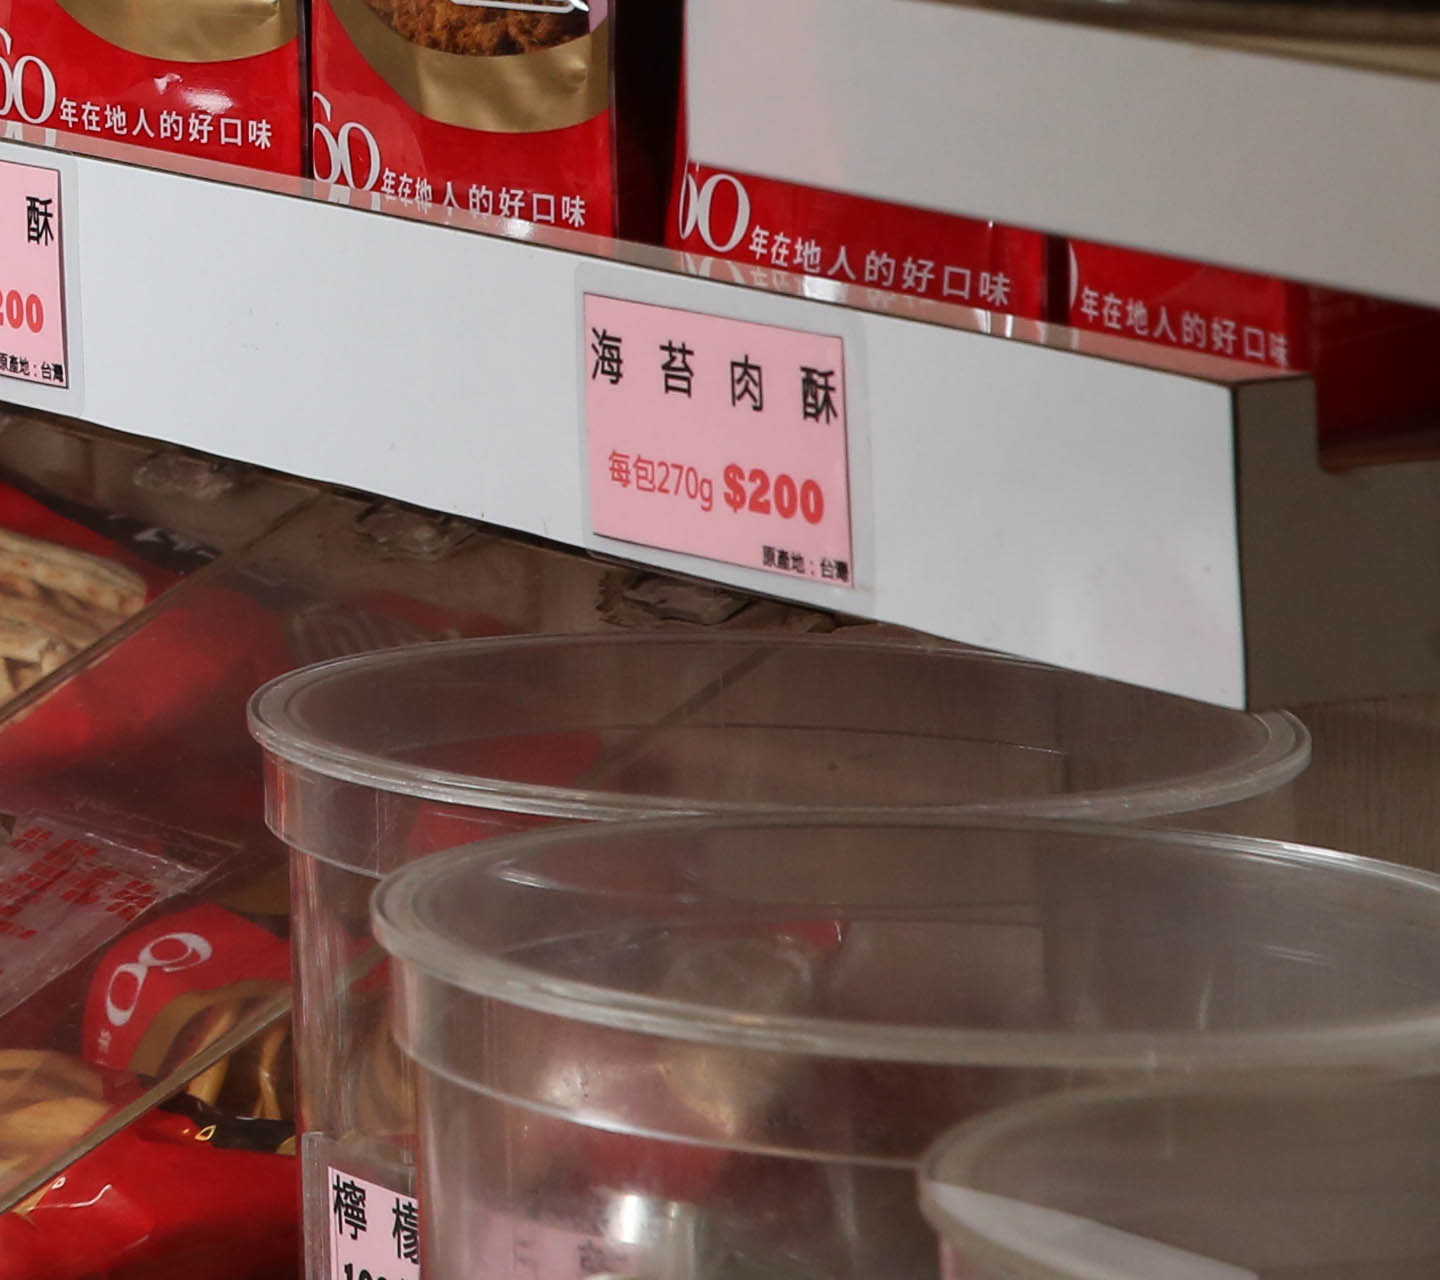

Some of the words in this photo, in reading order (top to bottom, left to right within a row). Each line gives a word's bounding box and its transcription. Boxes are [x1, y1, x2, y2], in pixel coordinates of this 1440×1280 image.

[591, 327, 838, 425] 海苔肉酥
[608, 450, 713, 512] 每包270g
[723, 463, 825, 525] $200
